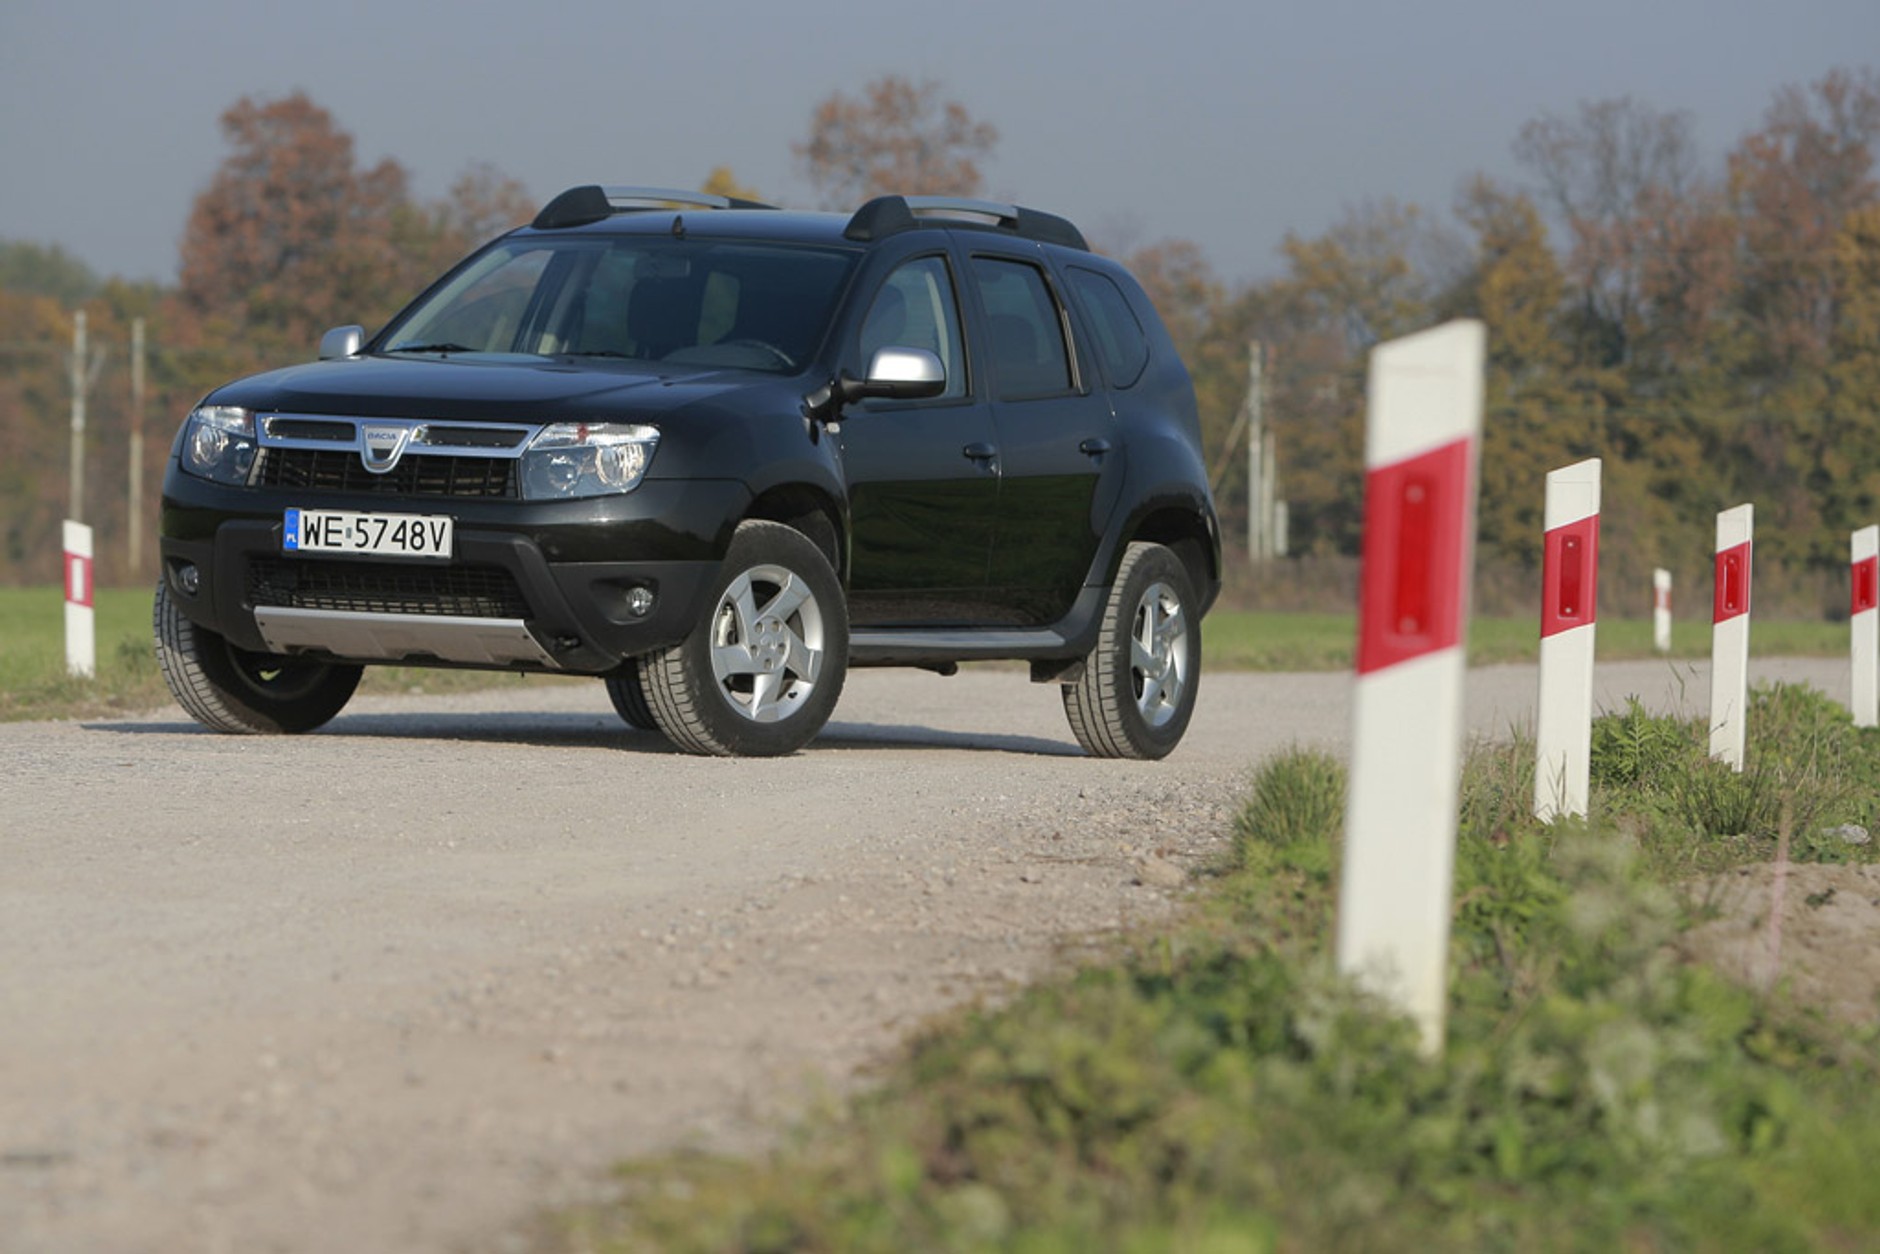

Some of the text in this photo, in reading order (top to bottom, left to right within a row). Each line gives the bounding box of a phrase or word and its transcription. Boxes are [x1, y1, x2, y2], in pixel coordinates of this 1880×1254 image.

[367, 432, 396, 440] DACIA
[286, 533, 297, 543] PL
[304, 515, 446, 551] WE 5748V
